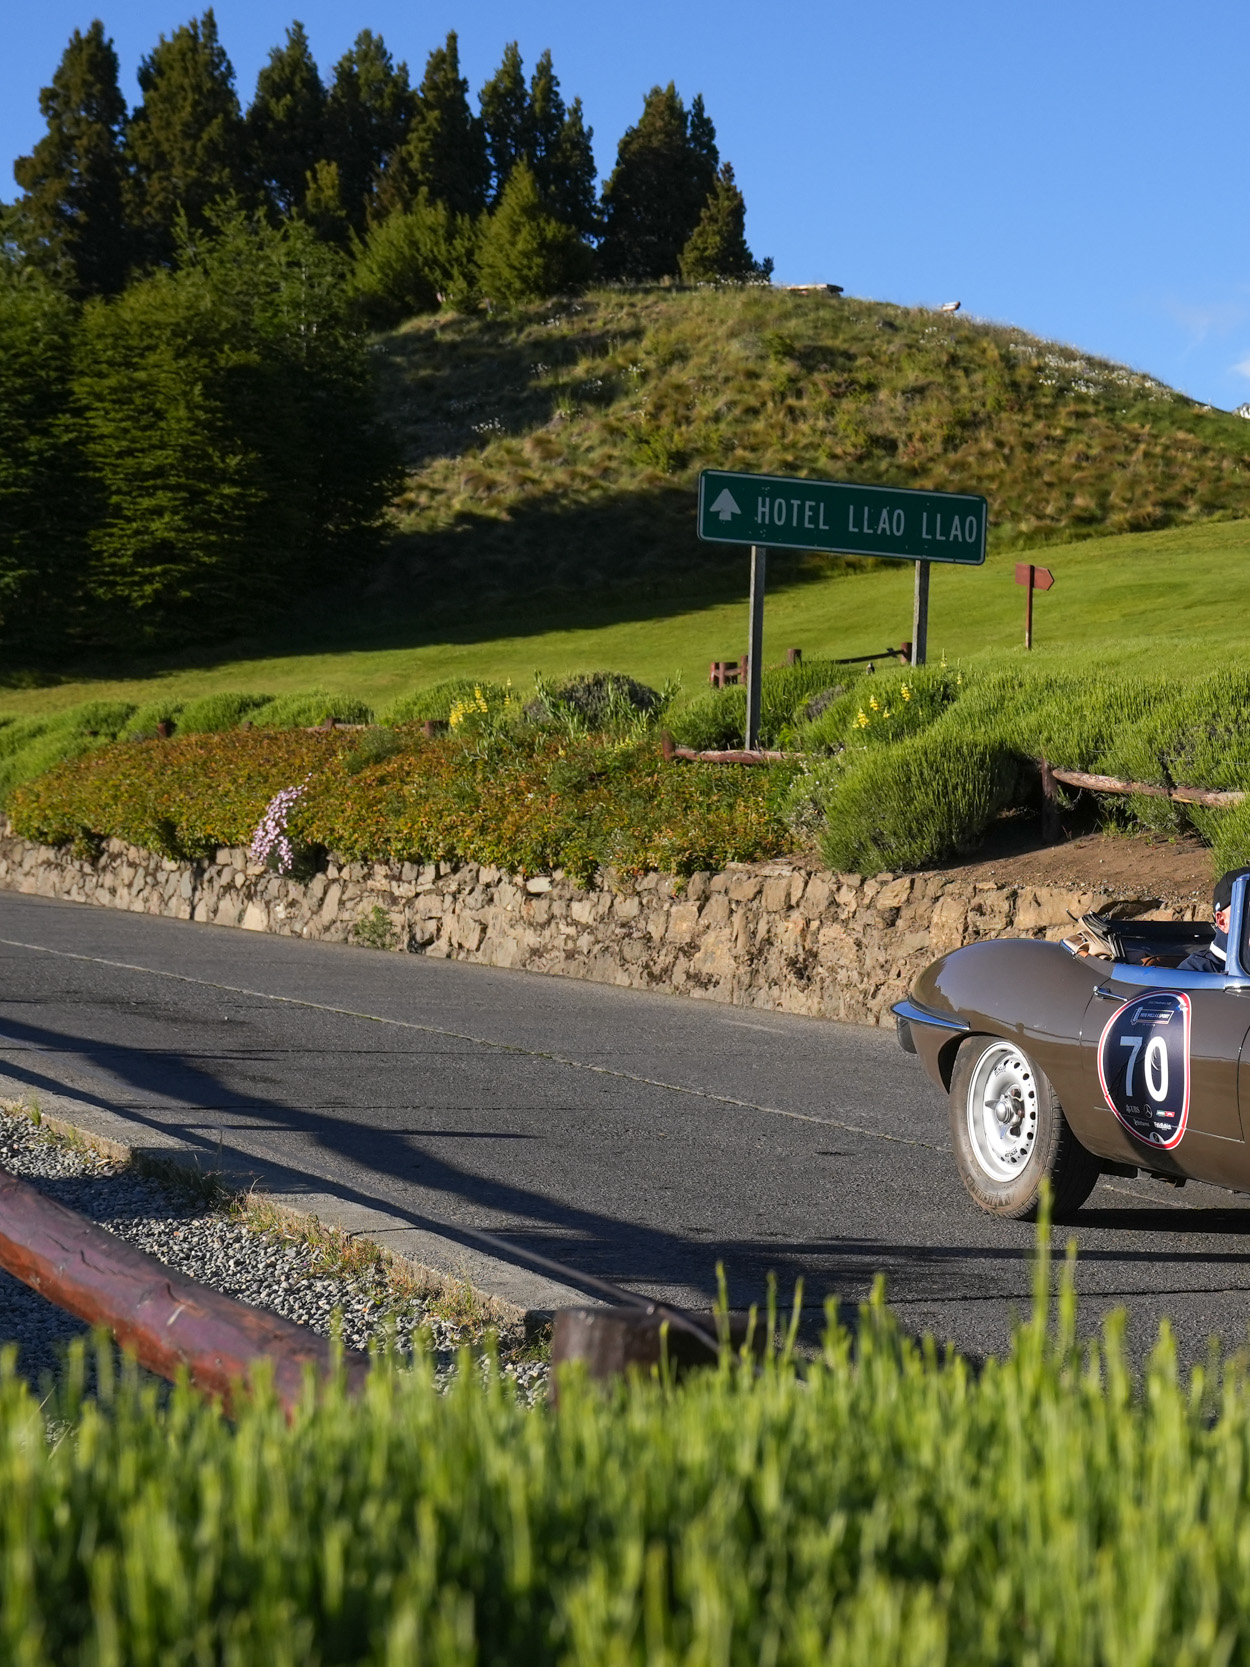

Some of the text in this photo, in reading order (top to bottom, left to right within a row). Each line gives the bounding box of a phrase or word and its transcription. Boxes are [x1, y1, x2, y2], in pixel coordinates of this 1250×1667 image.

[757, 497, 977, 543] HOTEL LLAO LLAO
[1119, 1035, 1168, 1102] 70
